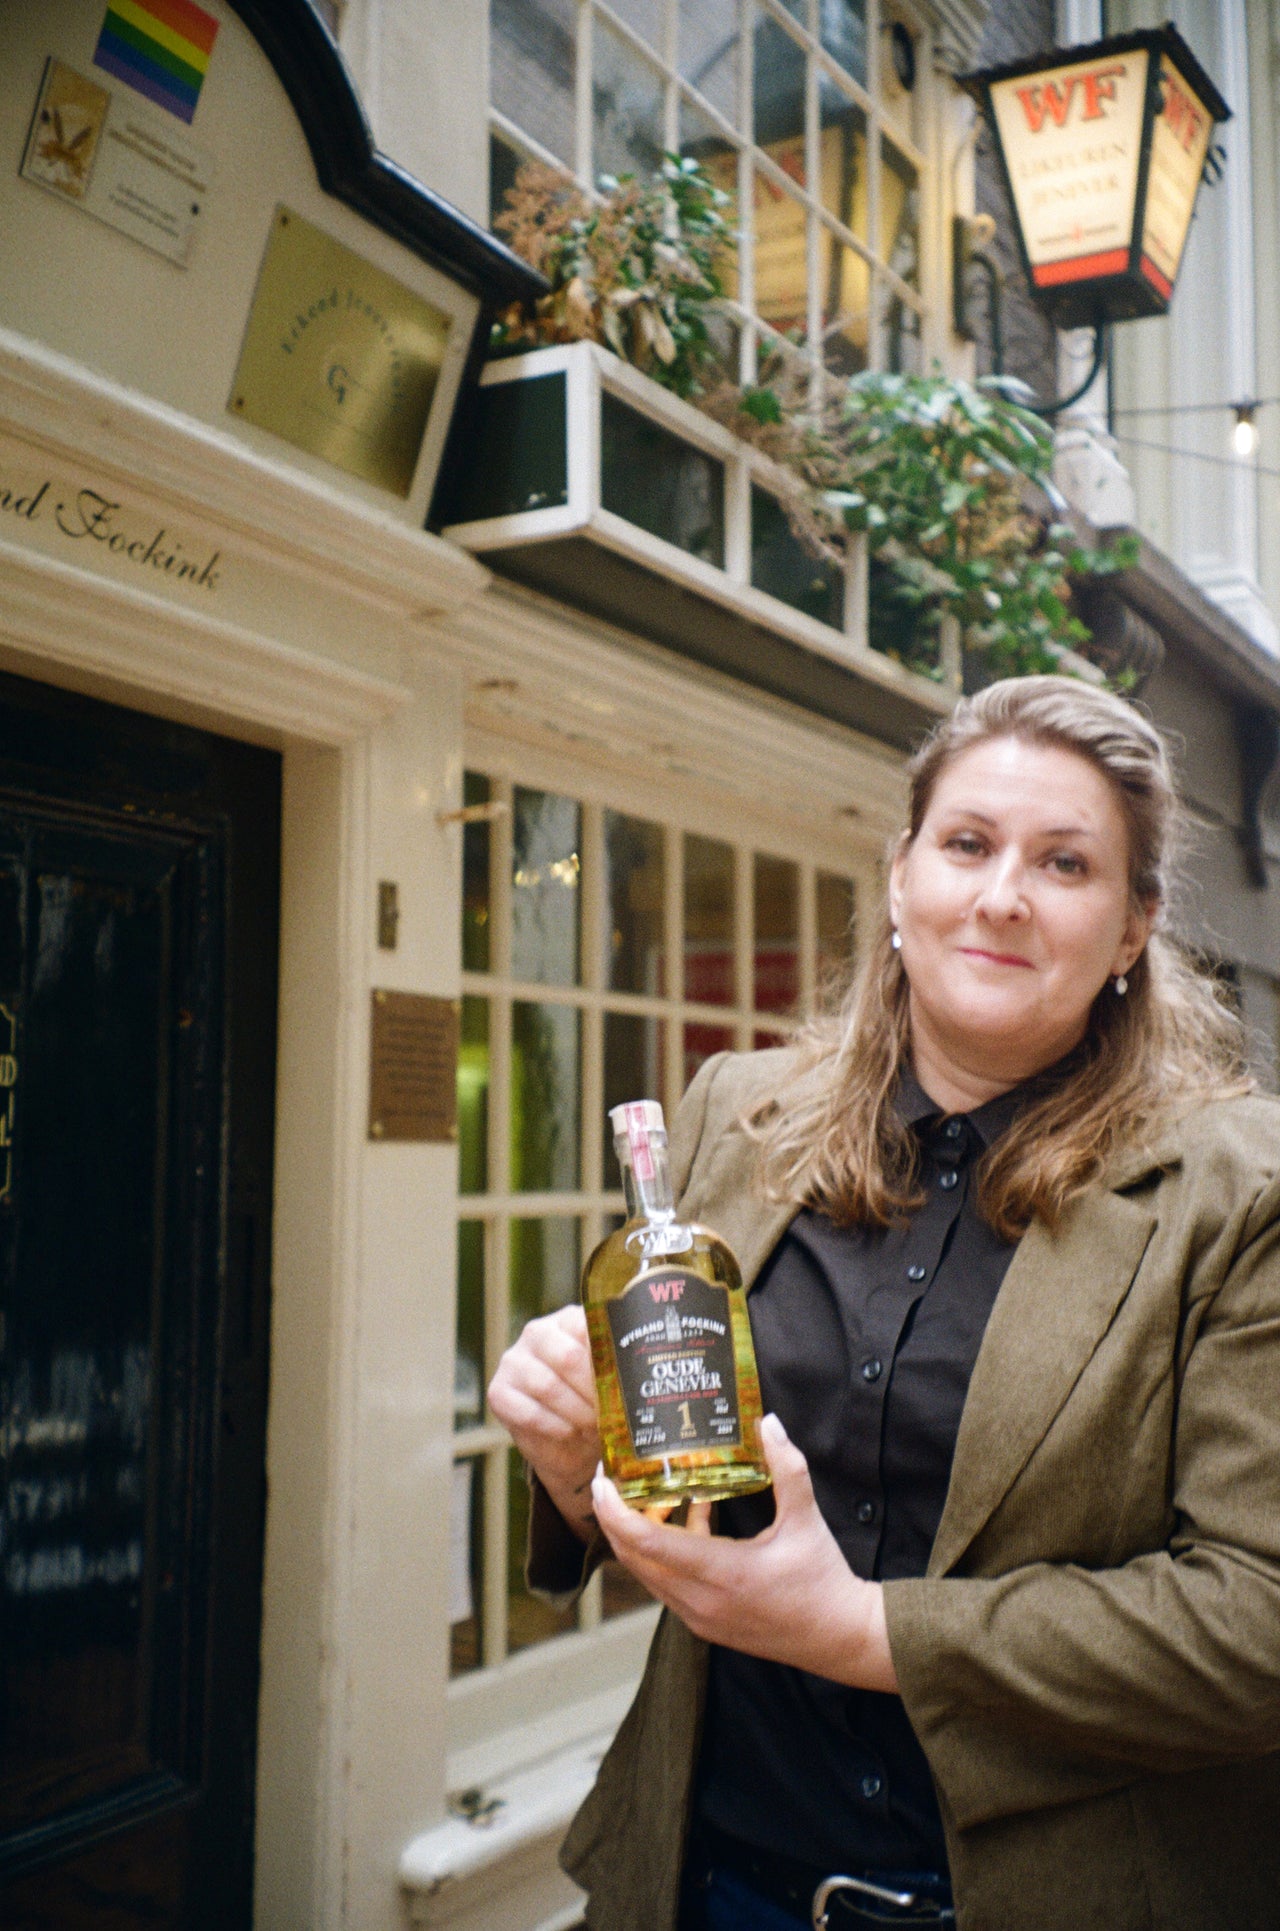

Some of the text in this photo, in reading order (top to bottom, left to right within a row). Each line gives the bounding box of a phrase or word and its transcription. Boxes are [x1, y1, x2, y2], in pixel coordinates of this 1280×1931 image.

[1016, 64, 1126, 133] WF
[55, 488, 220, 589] Fockink
[649, 1279, 686, 1304] WF
[619, 1320, 665, 1349] WYNAND
[651, 1357, 706, 1380] OUDE
[640, 1372, 722, 1398] GENEVER
[677, 1401, 696, 1431] 1
